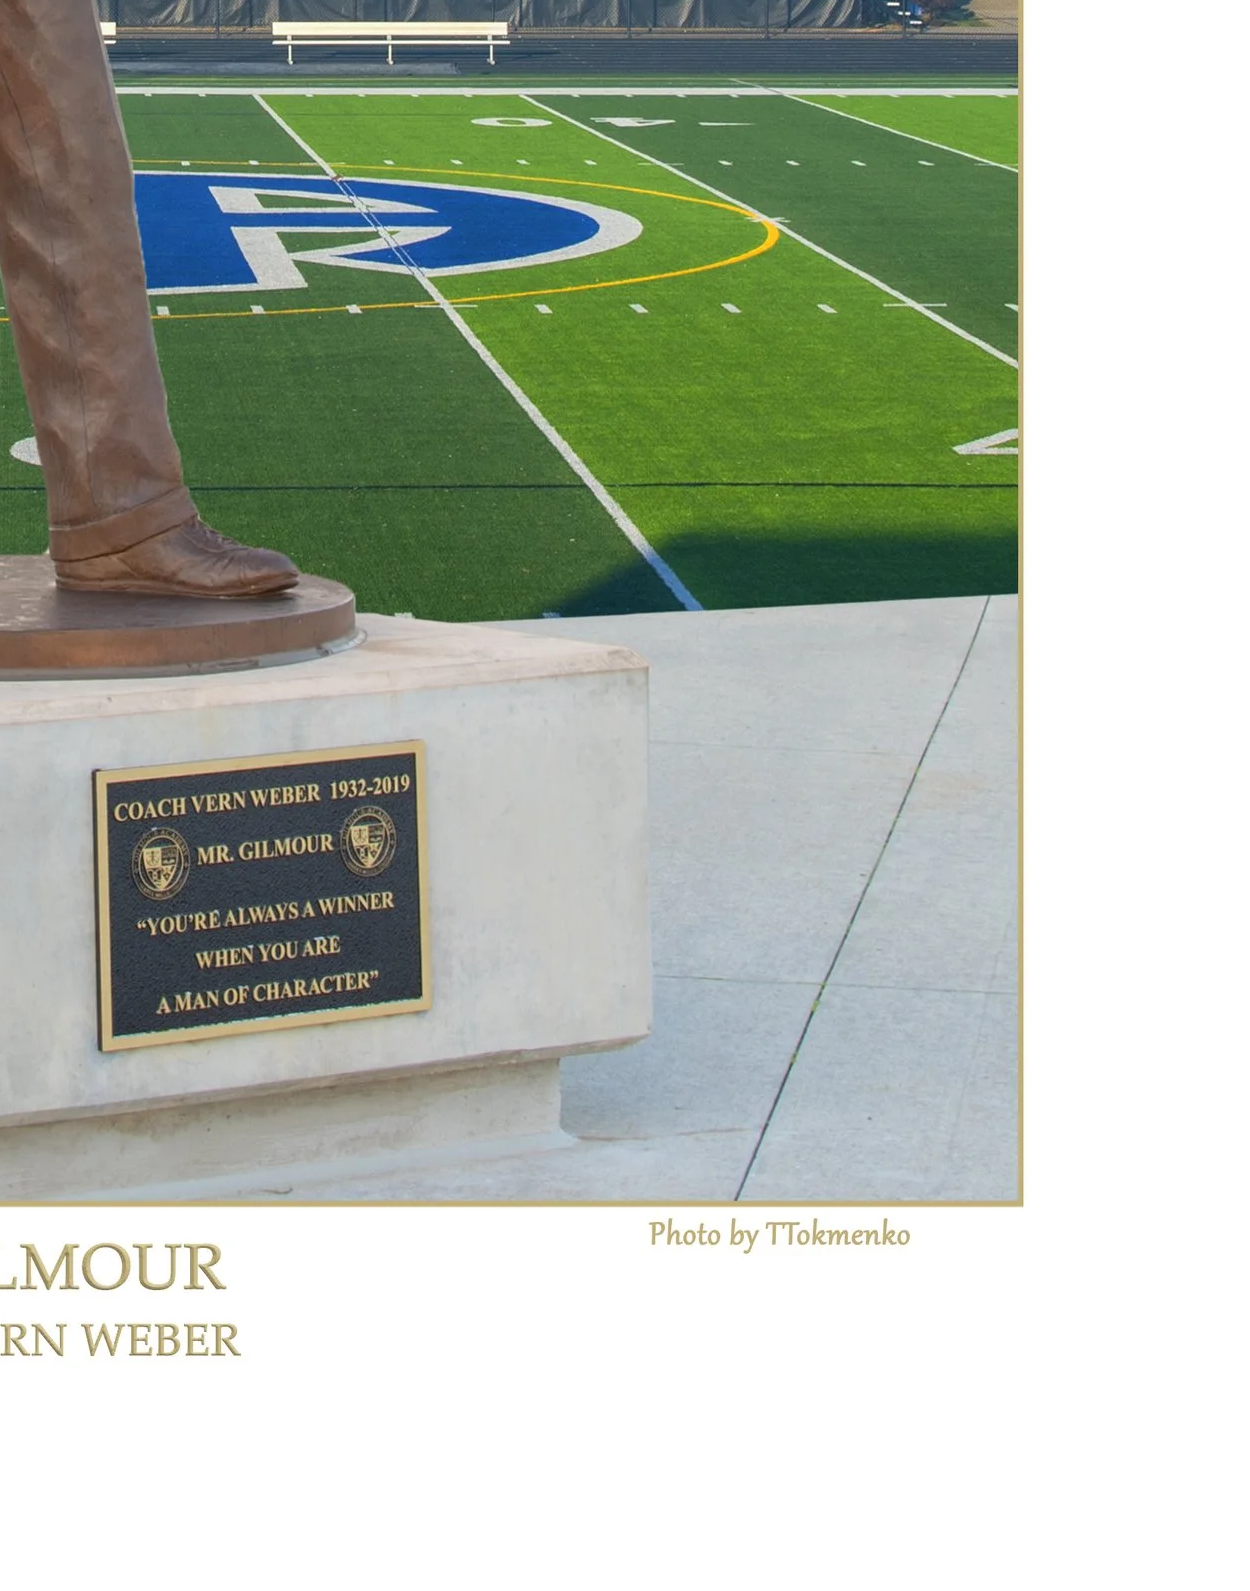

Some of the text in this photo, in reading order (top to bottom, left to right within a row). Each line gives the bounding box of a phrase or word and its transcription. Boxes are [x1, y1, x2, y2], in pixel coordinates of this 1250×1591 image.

[114, 773, 411, 822] COACH VERN WEBER 1932-2019
[197, 833, 335, 866] MR. GILMOUR
[224, 902, 300, 927] ALWAYS
[301, 900, 316, 918] A
[318, 891, 395, 915] WINNER
[196, 935, 342, 970] WHEN YOU ARE
[156, 996, 172, 1015] A
[175, 989, 220, 1011] MAN
[223, 985, 250, 1007] OF
